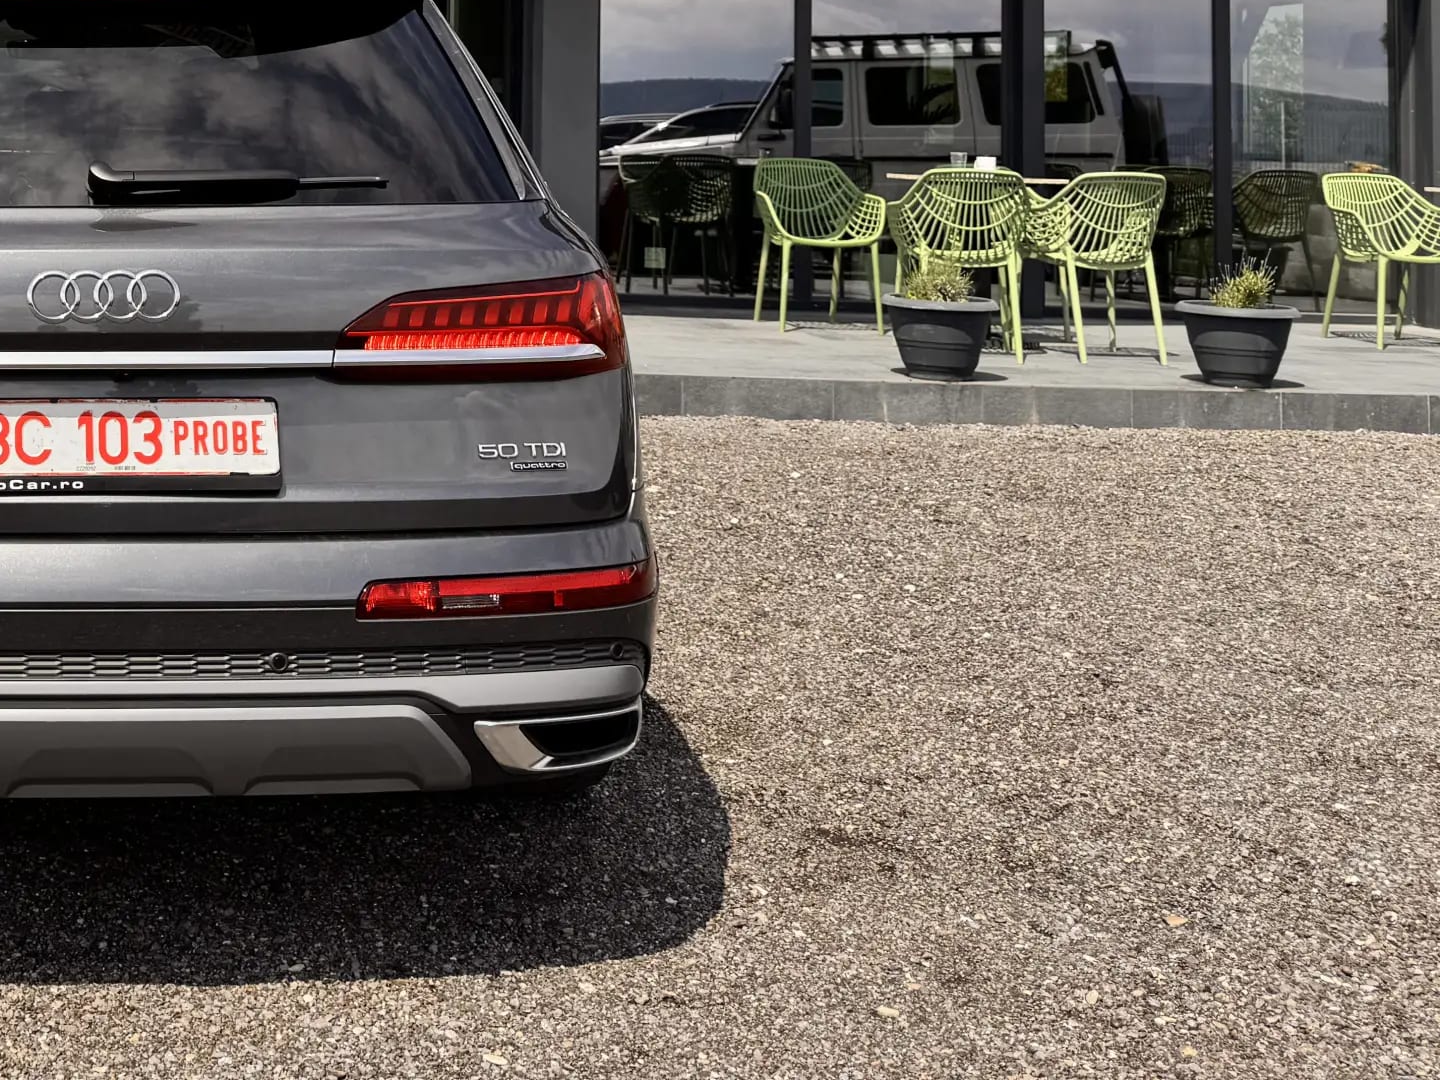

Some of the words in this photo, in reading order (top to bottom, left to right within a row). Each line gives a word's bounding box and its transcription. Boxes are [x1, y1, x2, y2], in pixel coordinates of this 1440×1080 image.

[77, 410, 164, 465] 103
[173, 419, 267, 456] PROBE
[478, 443, 519, 458] 50
[523, 441, 567, 457] TDI
[513, 461, 566, 470] quattro
